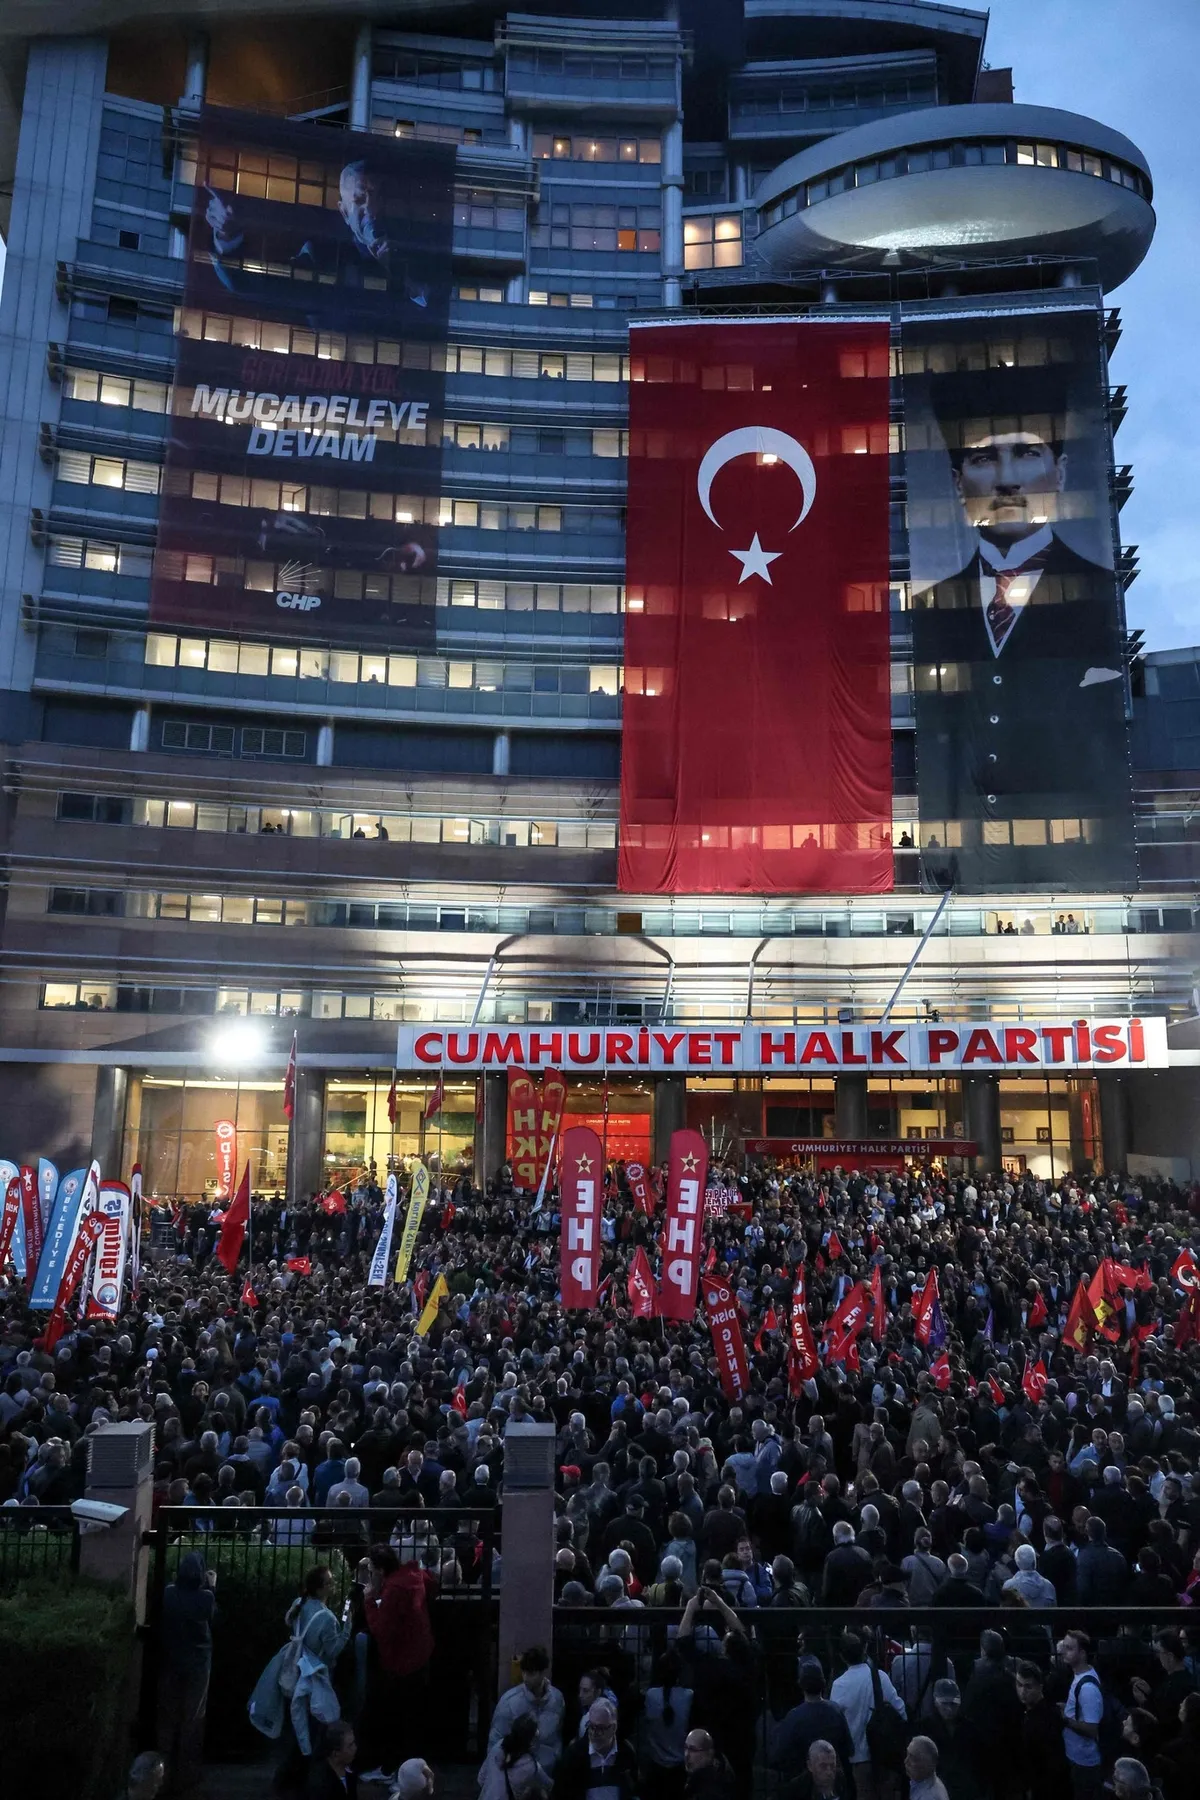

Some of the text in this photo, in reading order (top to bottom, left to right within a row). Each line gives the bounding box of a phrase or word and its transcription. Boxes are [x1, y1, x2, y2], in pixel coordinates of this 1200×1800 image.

[190, 384, 429, 430] MÜCADELEYE
[247, 427, 378, 462] DEVAM
[276, 592, 321, 611] CHP
[414, 1018, 1145, 1064] CUMHURİYET HALK PARTİSİ
[791, 1142, 930, 1153] CUMHURİYET HALK PARTİSİ
[48, 1197, 71, 1268] BELEDİYE
